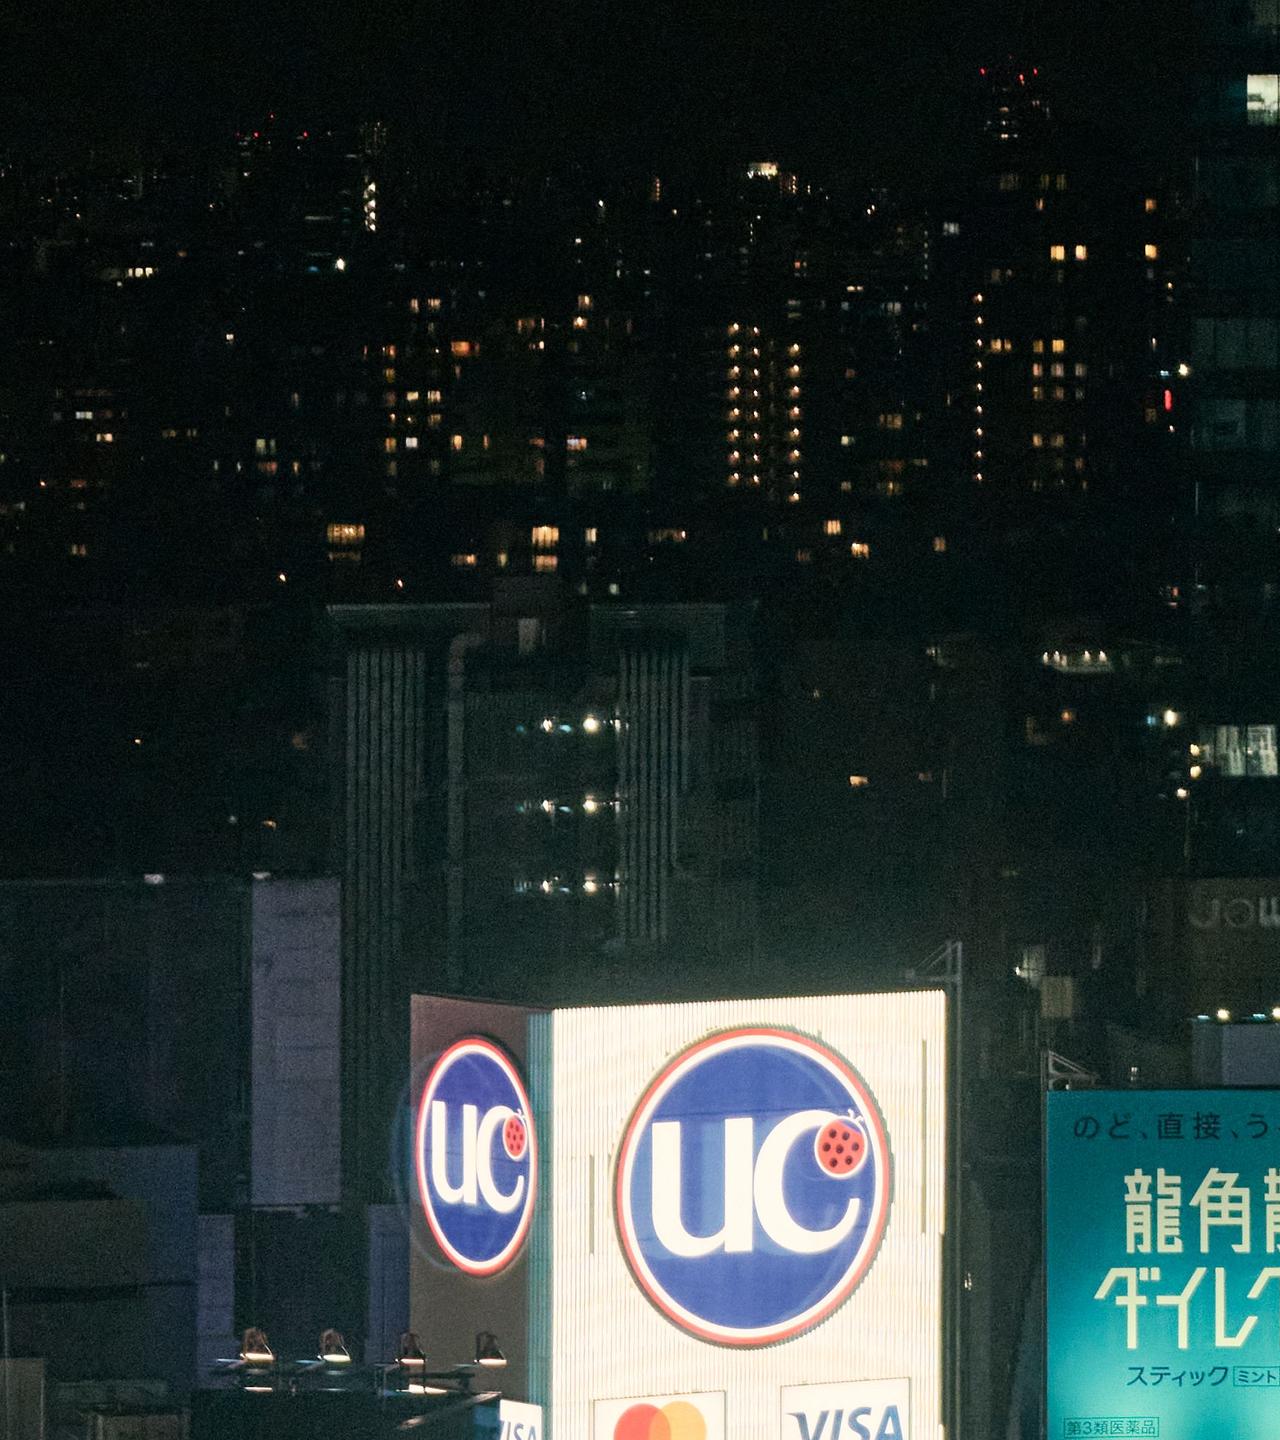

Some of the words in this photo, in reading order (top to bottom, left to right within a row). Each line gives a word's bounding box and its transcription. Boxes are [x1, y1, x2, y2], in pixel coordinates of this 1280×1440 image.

[1126, 1365, 1230, 1388] スティック
[1235, 1368, 1279, 1385] ミント
